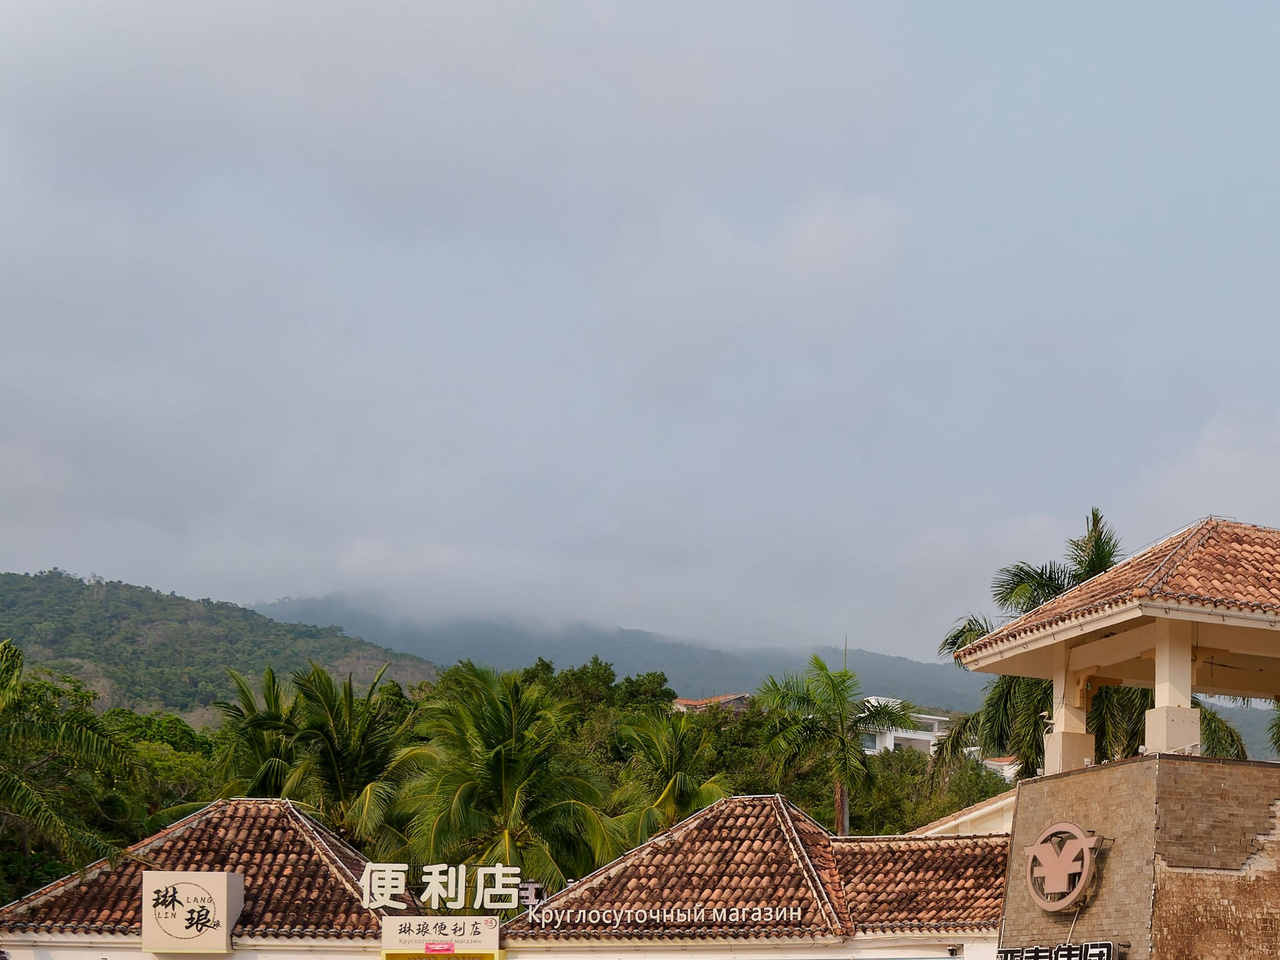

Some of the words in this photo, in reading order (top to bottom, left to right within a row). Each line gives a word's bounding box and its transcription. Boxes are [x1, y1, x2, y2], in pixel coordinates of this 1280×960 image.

[358, 862, 521, 910] 便利店
[157, 911, 177, 919] LIN
[528, 902, 706, 928] Круглосуточный
[712, 906, 802, 922] магазин
[398, 921, 482, 937] 琳琅便利店
